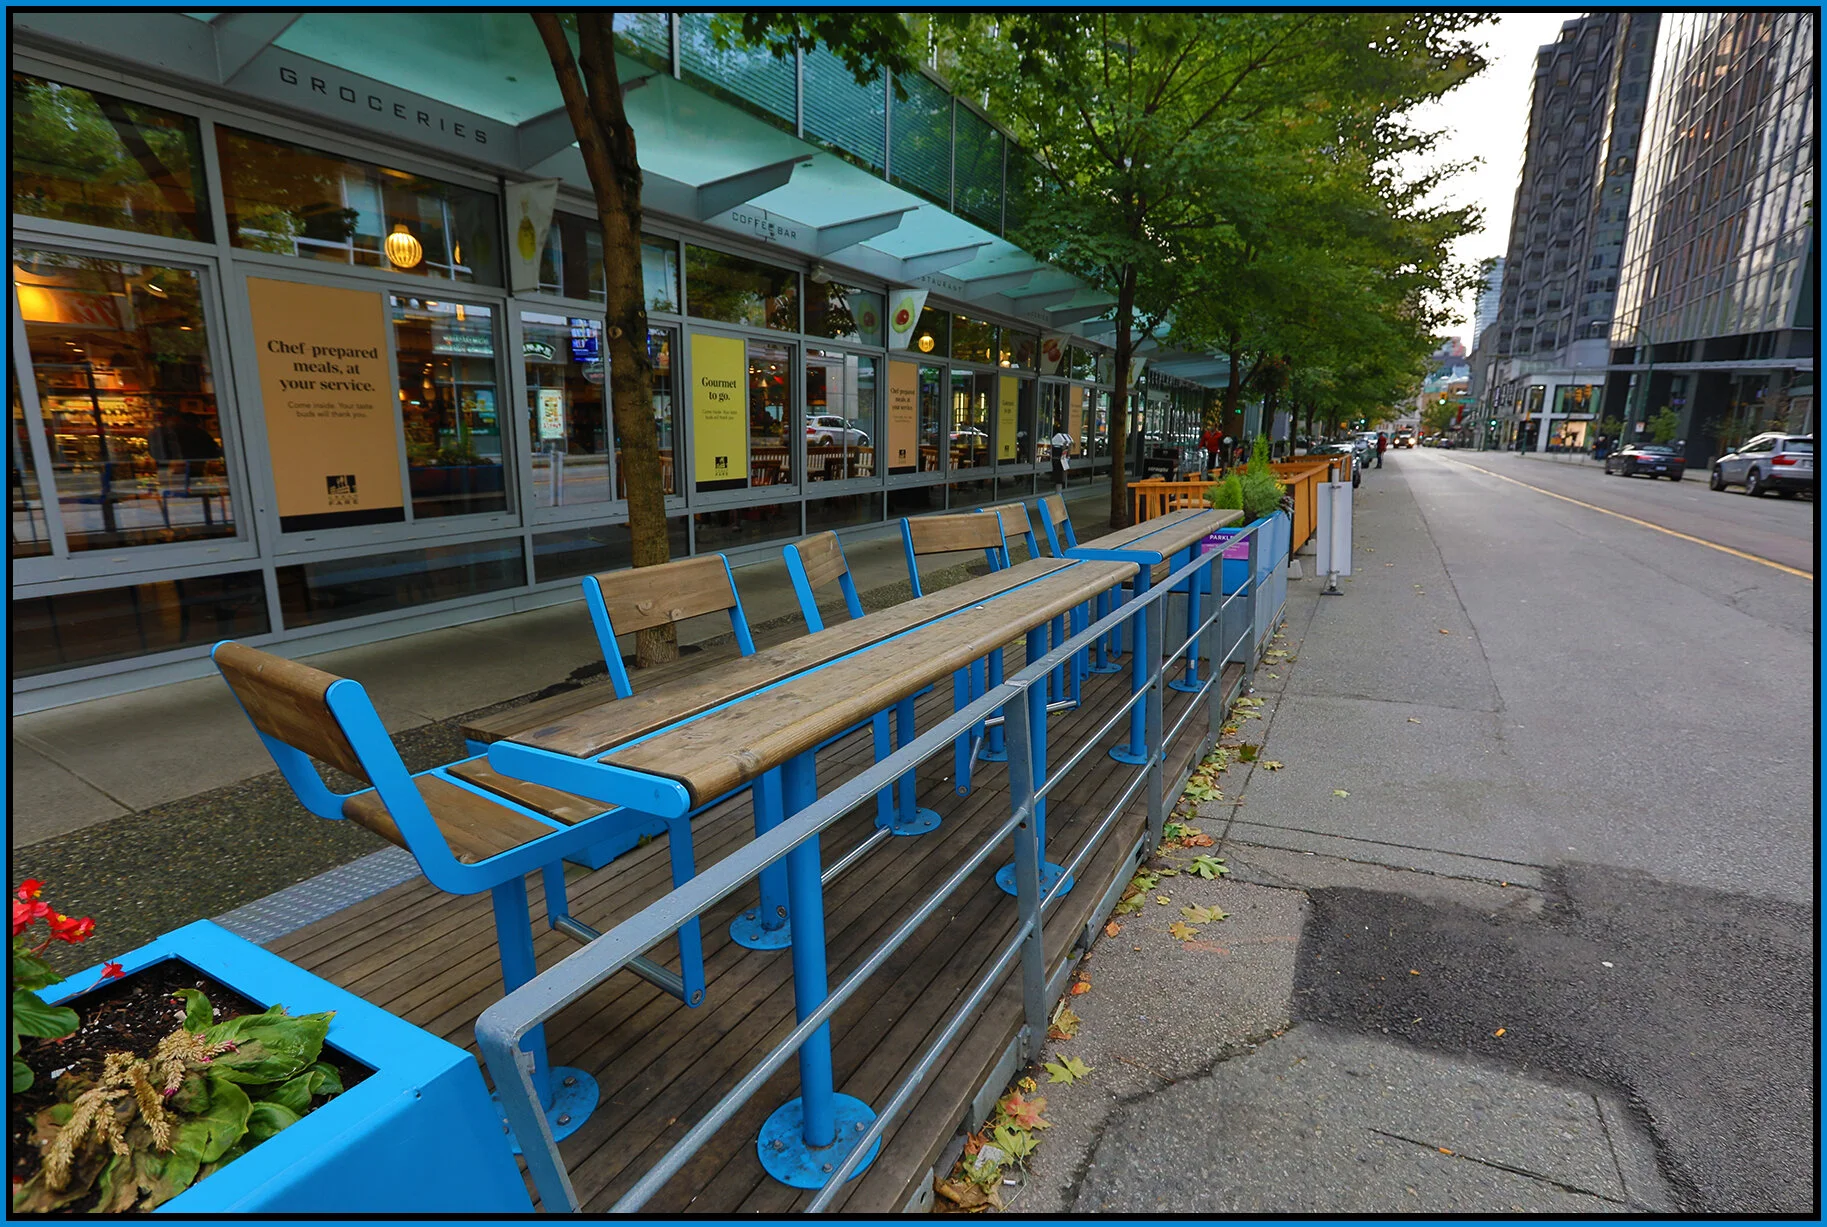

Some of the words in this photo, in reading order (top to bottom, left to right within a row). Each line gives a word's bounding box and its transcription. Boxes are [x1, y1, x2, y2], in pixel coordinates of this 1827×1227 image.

[279, 67, 488, 144] GROCERIES
[777, 227, 797, 240] BAR
[917, 275, 963, 293] STAURANT
[267, 340, 306, 355] Chef
[312, 346, 379, 360] prepared
[293, 361, 343, 375] meals,
[347, 364, 360, 375] at
[279, 379, 316, 392] your
[320, 379, 376, 392] service.
[701, 376, 737, 389] Gourmet
[709, 391, 718, 400] to
[718, 392, 730, 402] go.
[287, 400, 312, 409] Come
